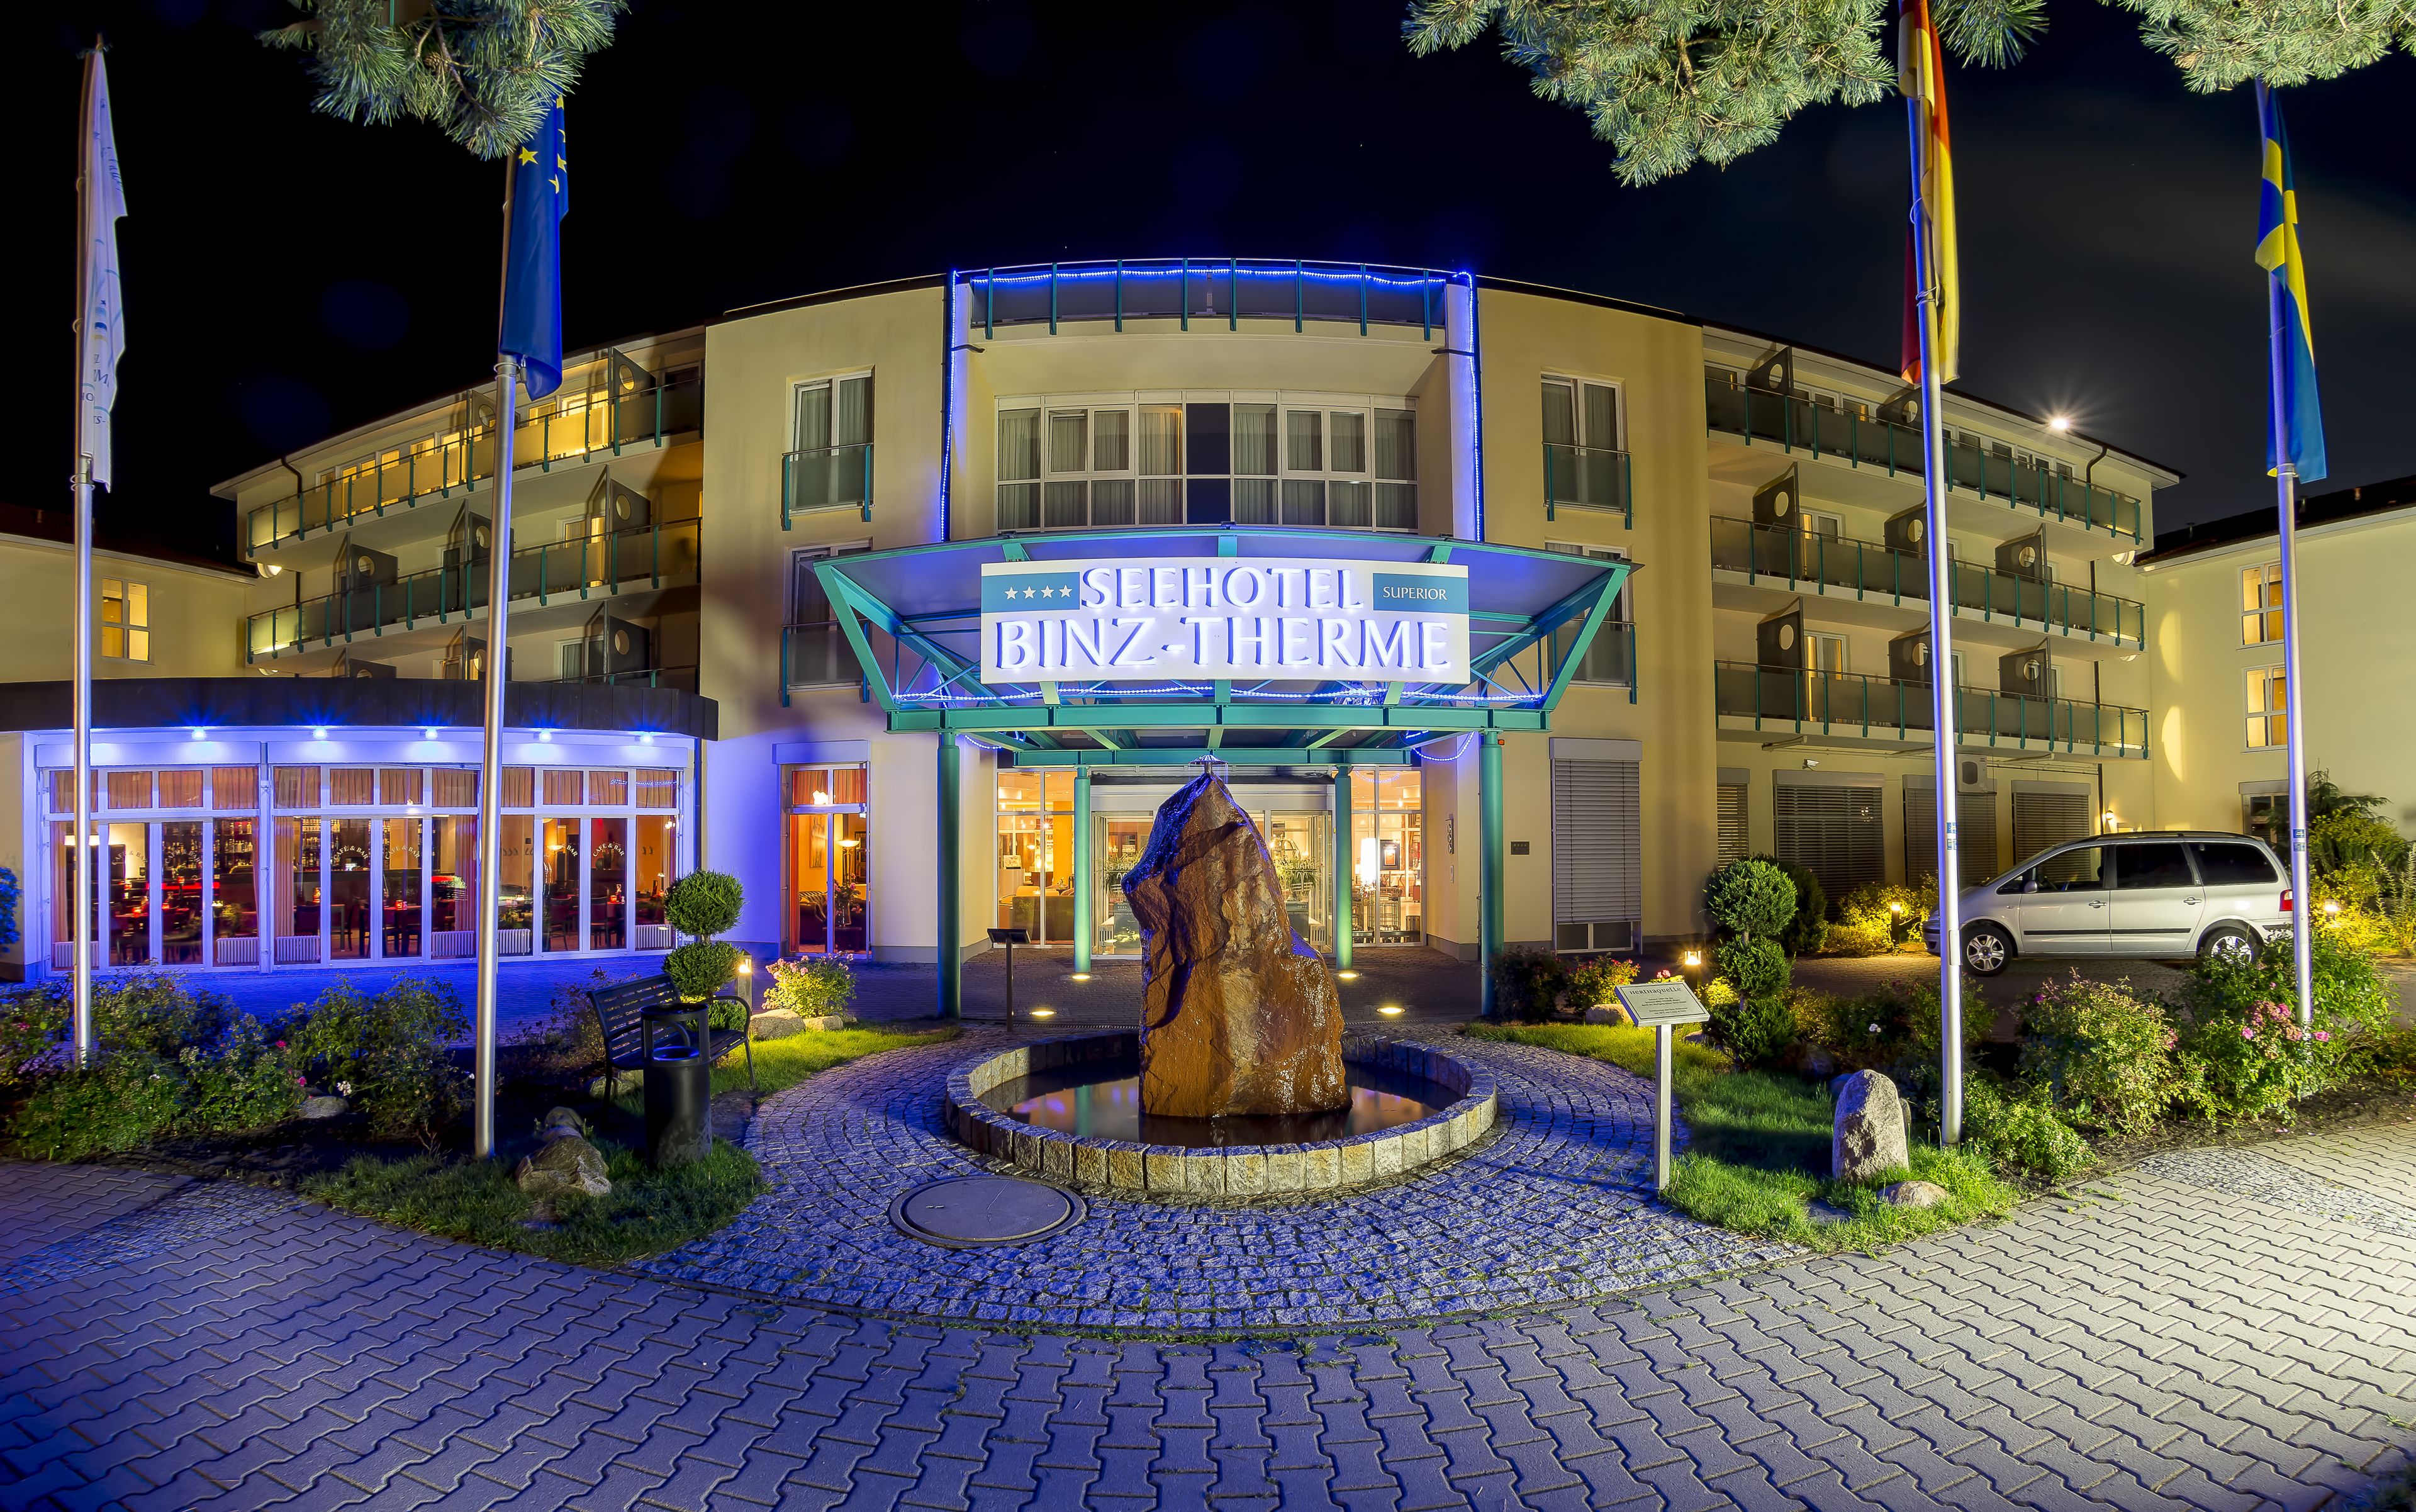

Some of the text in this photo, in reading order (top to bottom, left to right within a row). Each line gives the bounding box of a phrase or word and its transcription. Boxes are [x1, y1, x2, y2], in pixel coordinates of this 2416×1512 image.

[1082, 566, 1364, 609] SEEHOTEL
[1383, 586, 1448, 600] SUPERIOR
[996, 617, 1451, 669] BINZ-THERME
[356, 847, 369, 860] BAR
[408, 846, 420, 859] BAR
[566, 844, 578, 856] BAR
[613, 844, 625, 856] BAR
